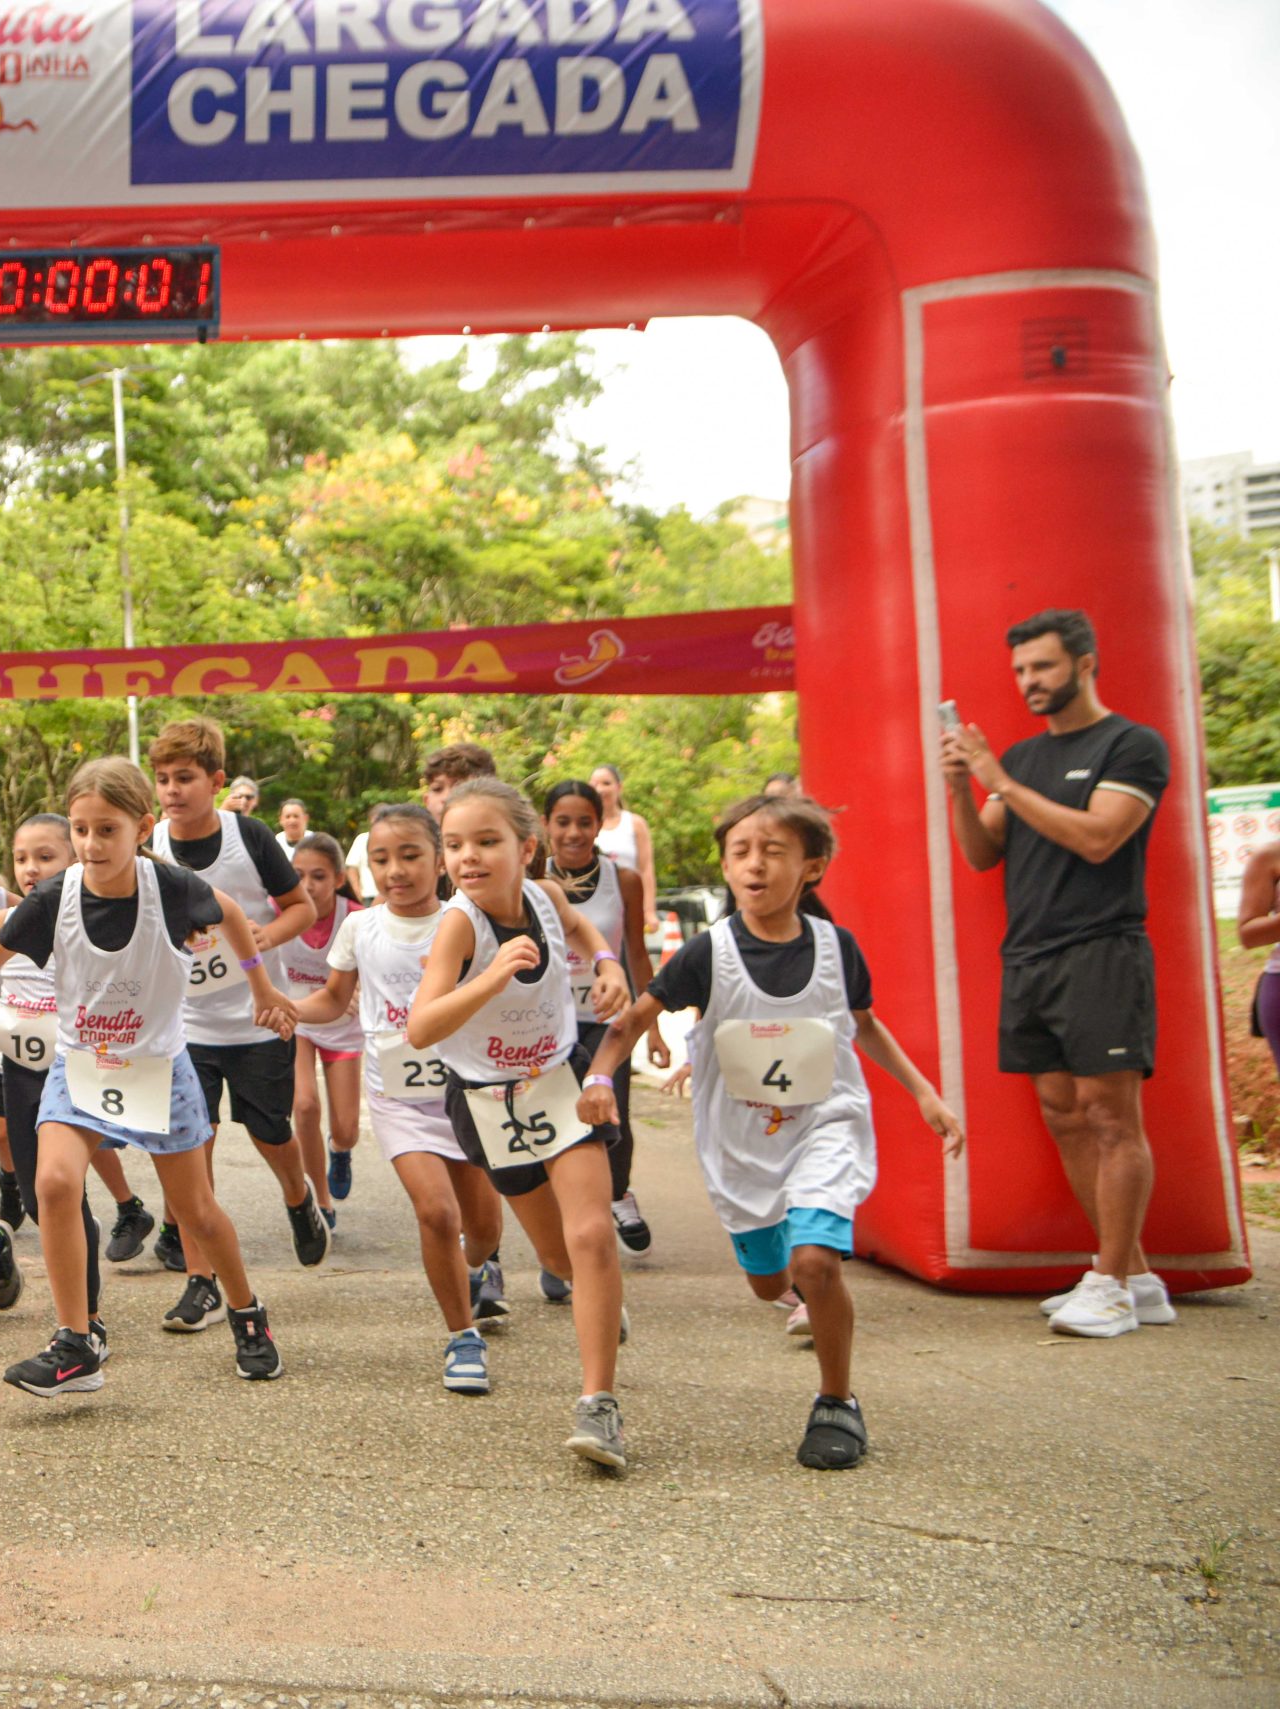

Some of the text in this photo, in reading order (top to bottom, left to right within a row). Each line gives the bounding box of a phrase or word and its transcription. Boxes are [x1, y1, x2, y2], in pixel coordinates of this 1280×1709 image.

[175, 0, 696, 56] LARGADA
[167, 53, 700, 146] CHEGADA
[190, 955, 227, 985] 56
[75, 1005, 144, 1031] Bendita
[11, 1035, 46, 1062] 19
[403, 1059, 448, 1087] 23
[762, 1059, 792, 1092] 4
[101, 1089, 124, 1115] 8
[501, 1110, 556, 1153] 25
